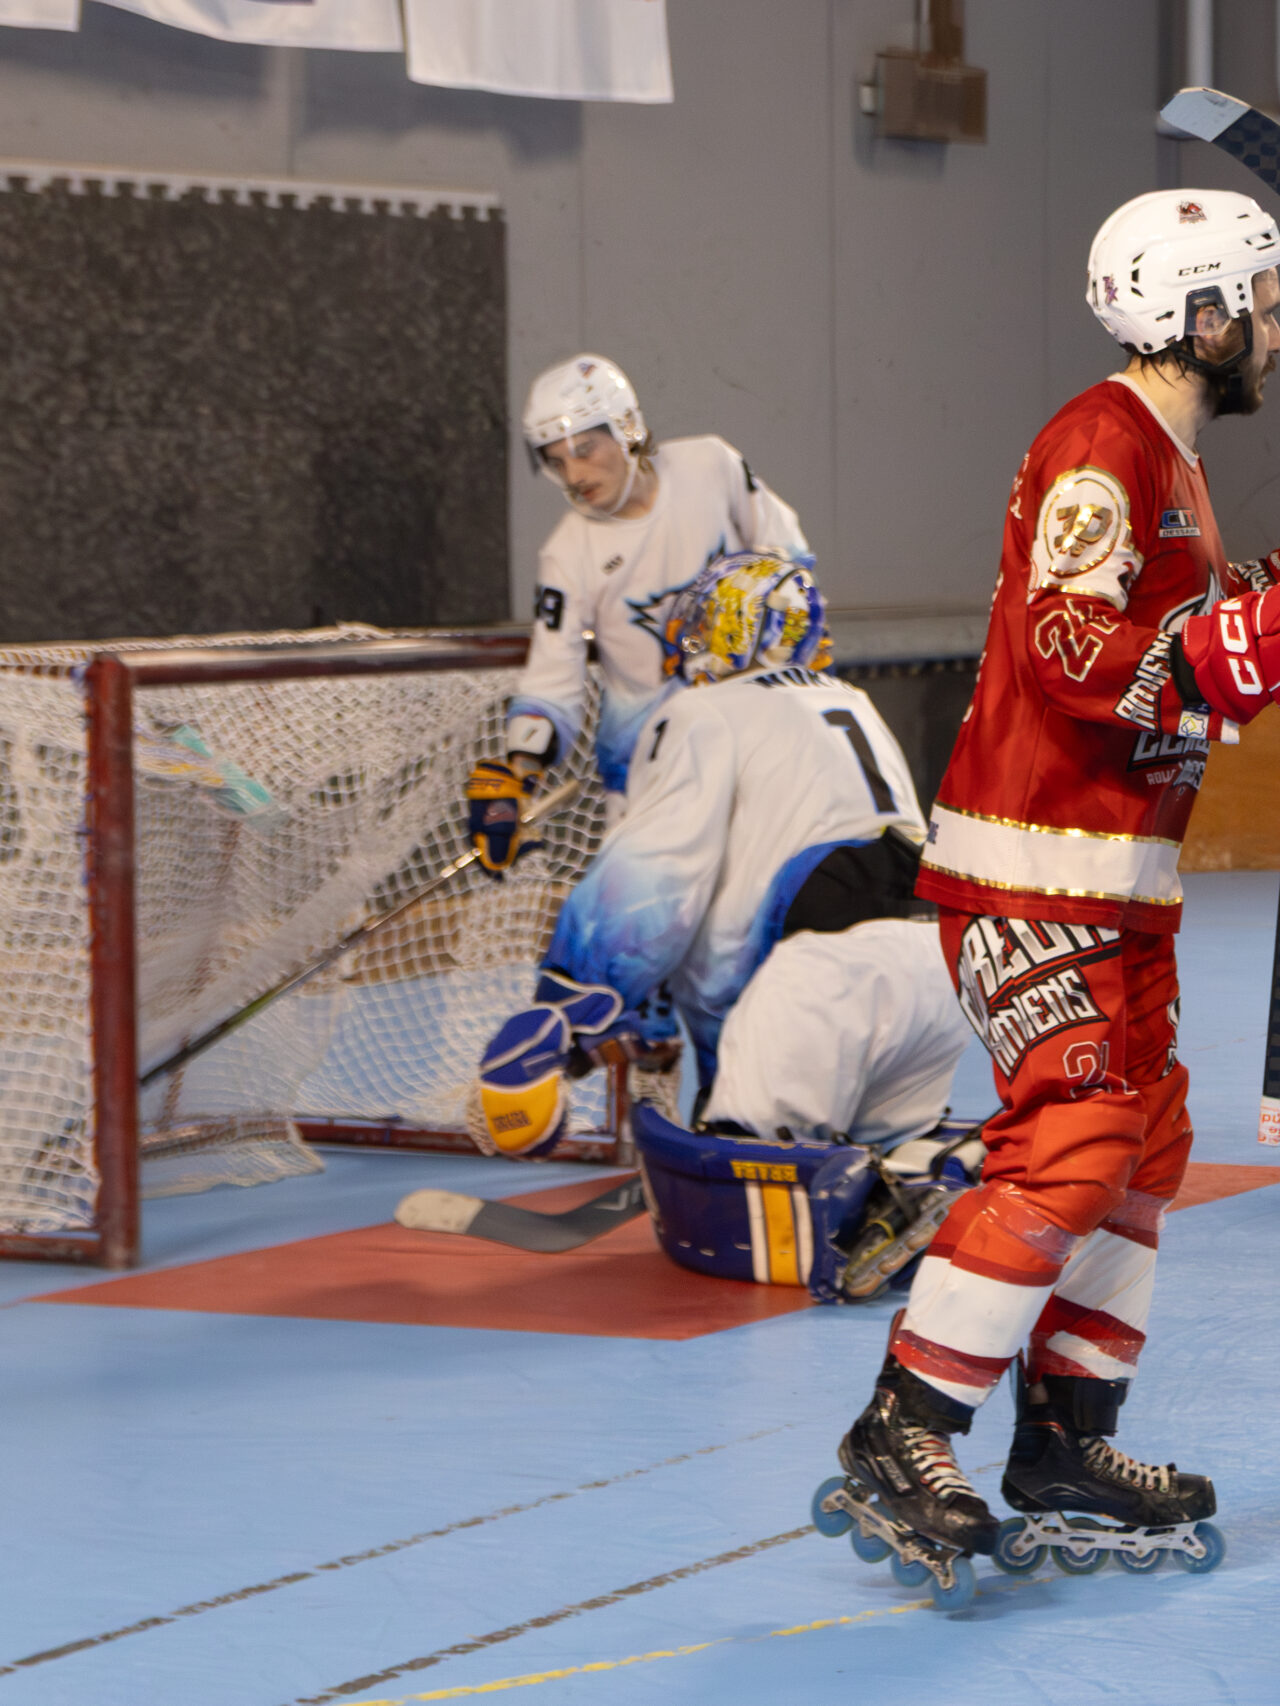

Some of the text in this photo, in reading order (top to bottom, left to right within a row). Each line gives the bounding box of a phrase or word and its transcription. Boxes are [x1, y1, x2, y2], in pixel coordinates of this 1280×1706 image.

[1178, 262, 1222, 277] CCM
[649, 719, 668, 763] 1
[821, 708, 899, 815] 1
